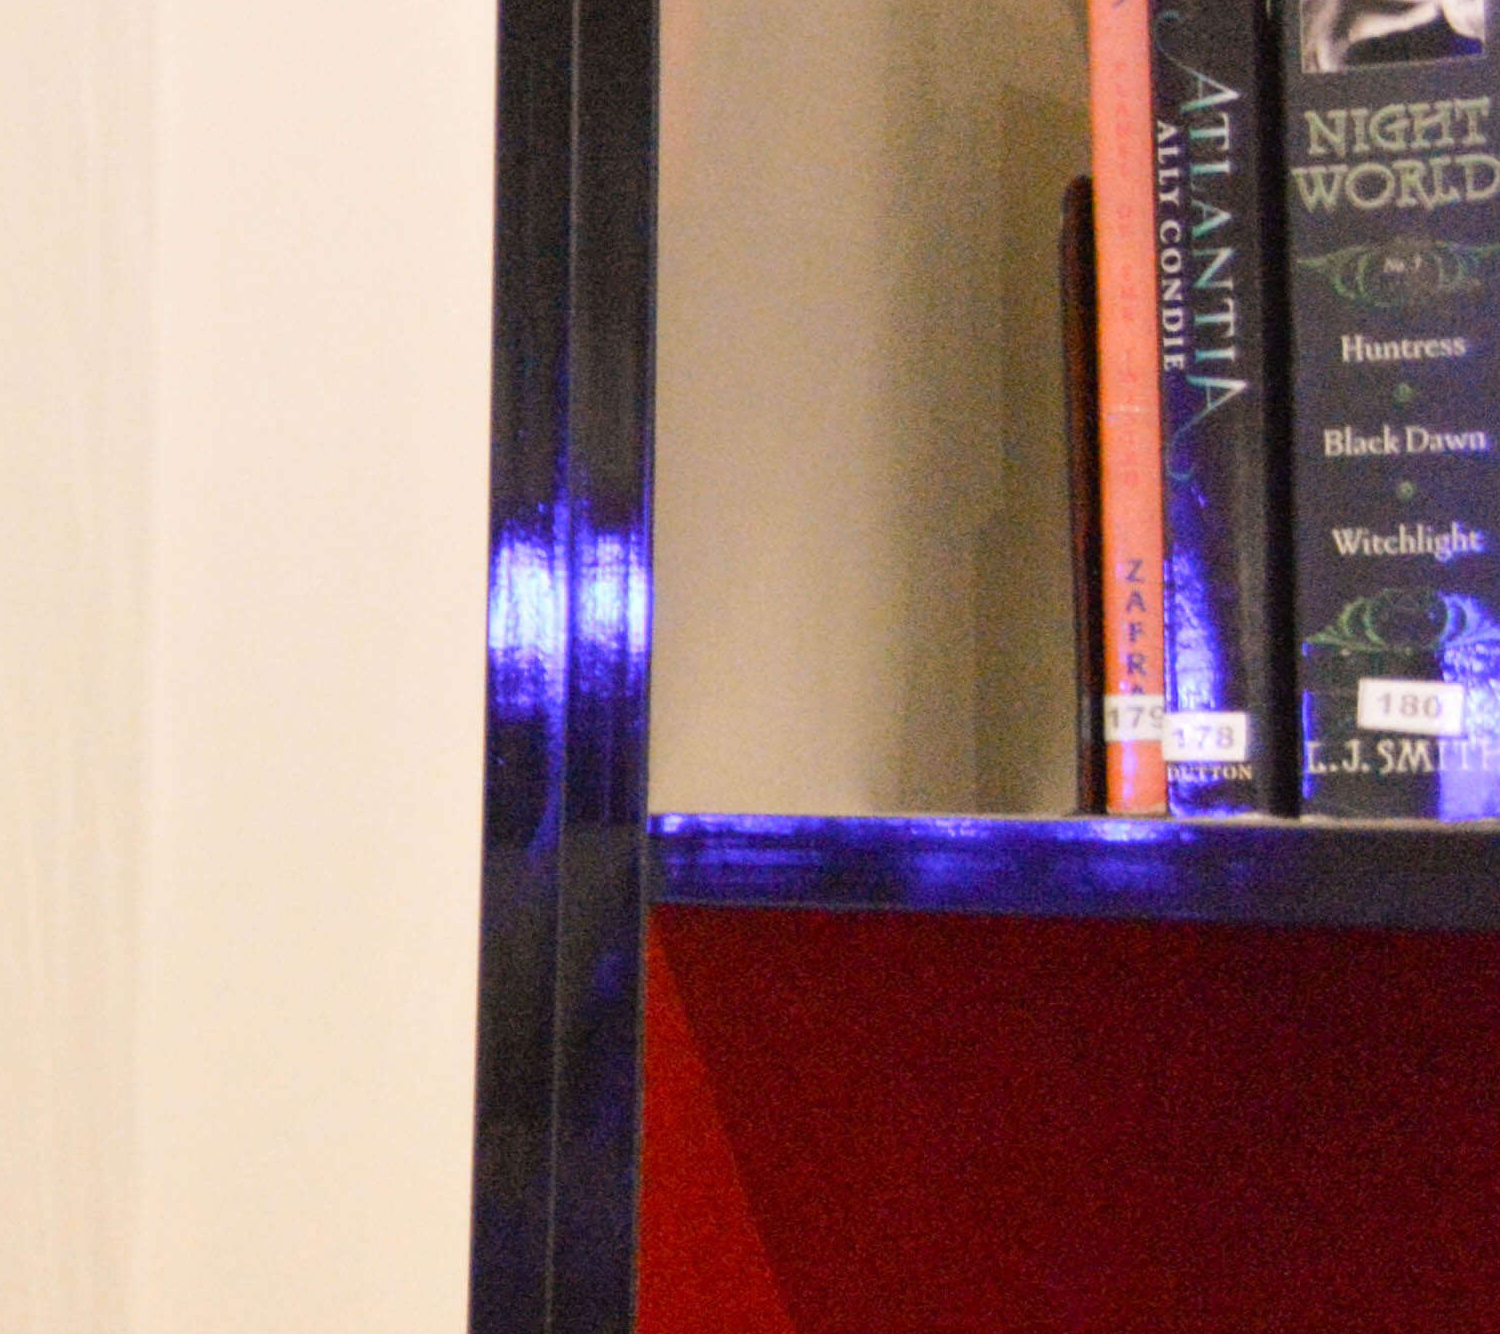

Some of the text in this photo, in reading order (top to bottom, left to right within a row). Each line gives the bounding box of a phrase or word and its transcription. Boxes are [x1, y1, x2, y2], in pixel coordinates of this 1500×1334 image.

[1304, 95, 1492, 158] NIGHT
[1291, 153, 1500, 213] WORLD
[1156, 118, 1185, 372] ALLY CONDIE
[1168, 42, 1249, 447] ATLANTIA
[1341, 332, 1468, 365] Huntress
[1323, 424, 1488, 458] Black Dawn
[1331, 521, 1486, 563] Witchlight
[1107, 705, 1165, 731] 179
[1376, 691, 1444, 720] 180
[1171, 724, 1236, 750] 178
[1167, 764, 1253, 781] DUTTON
